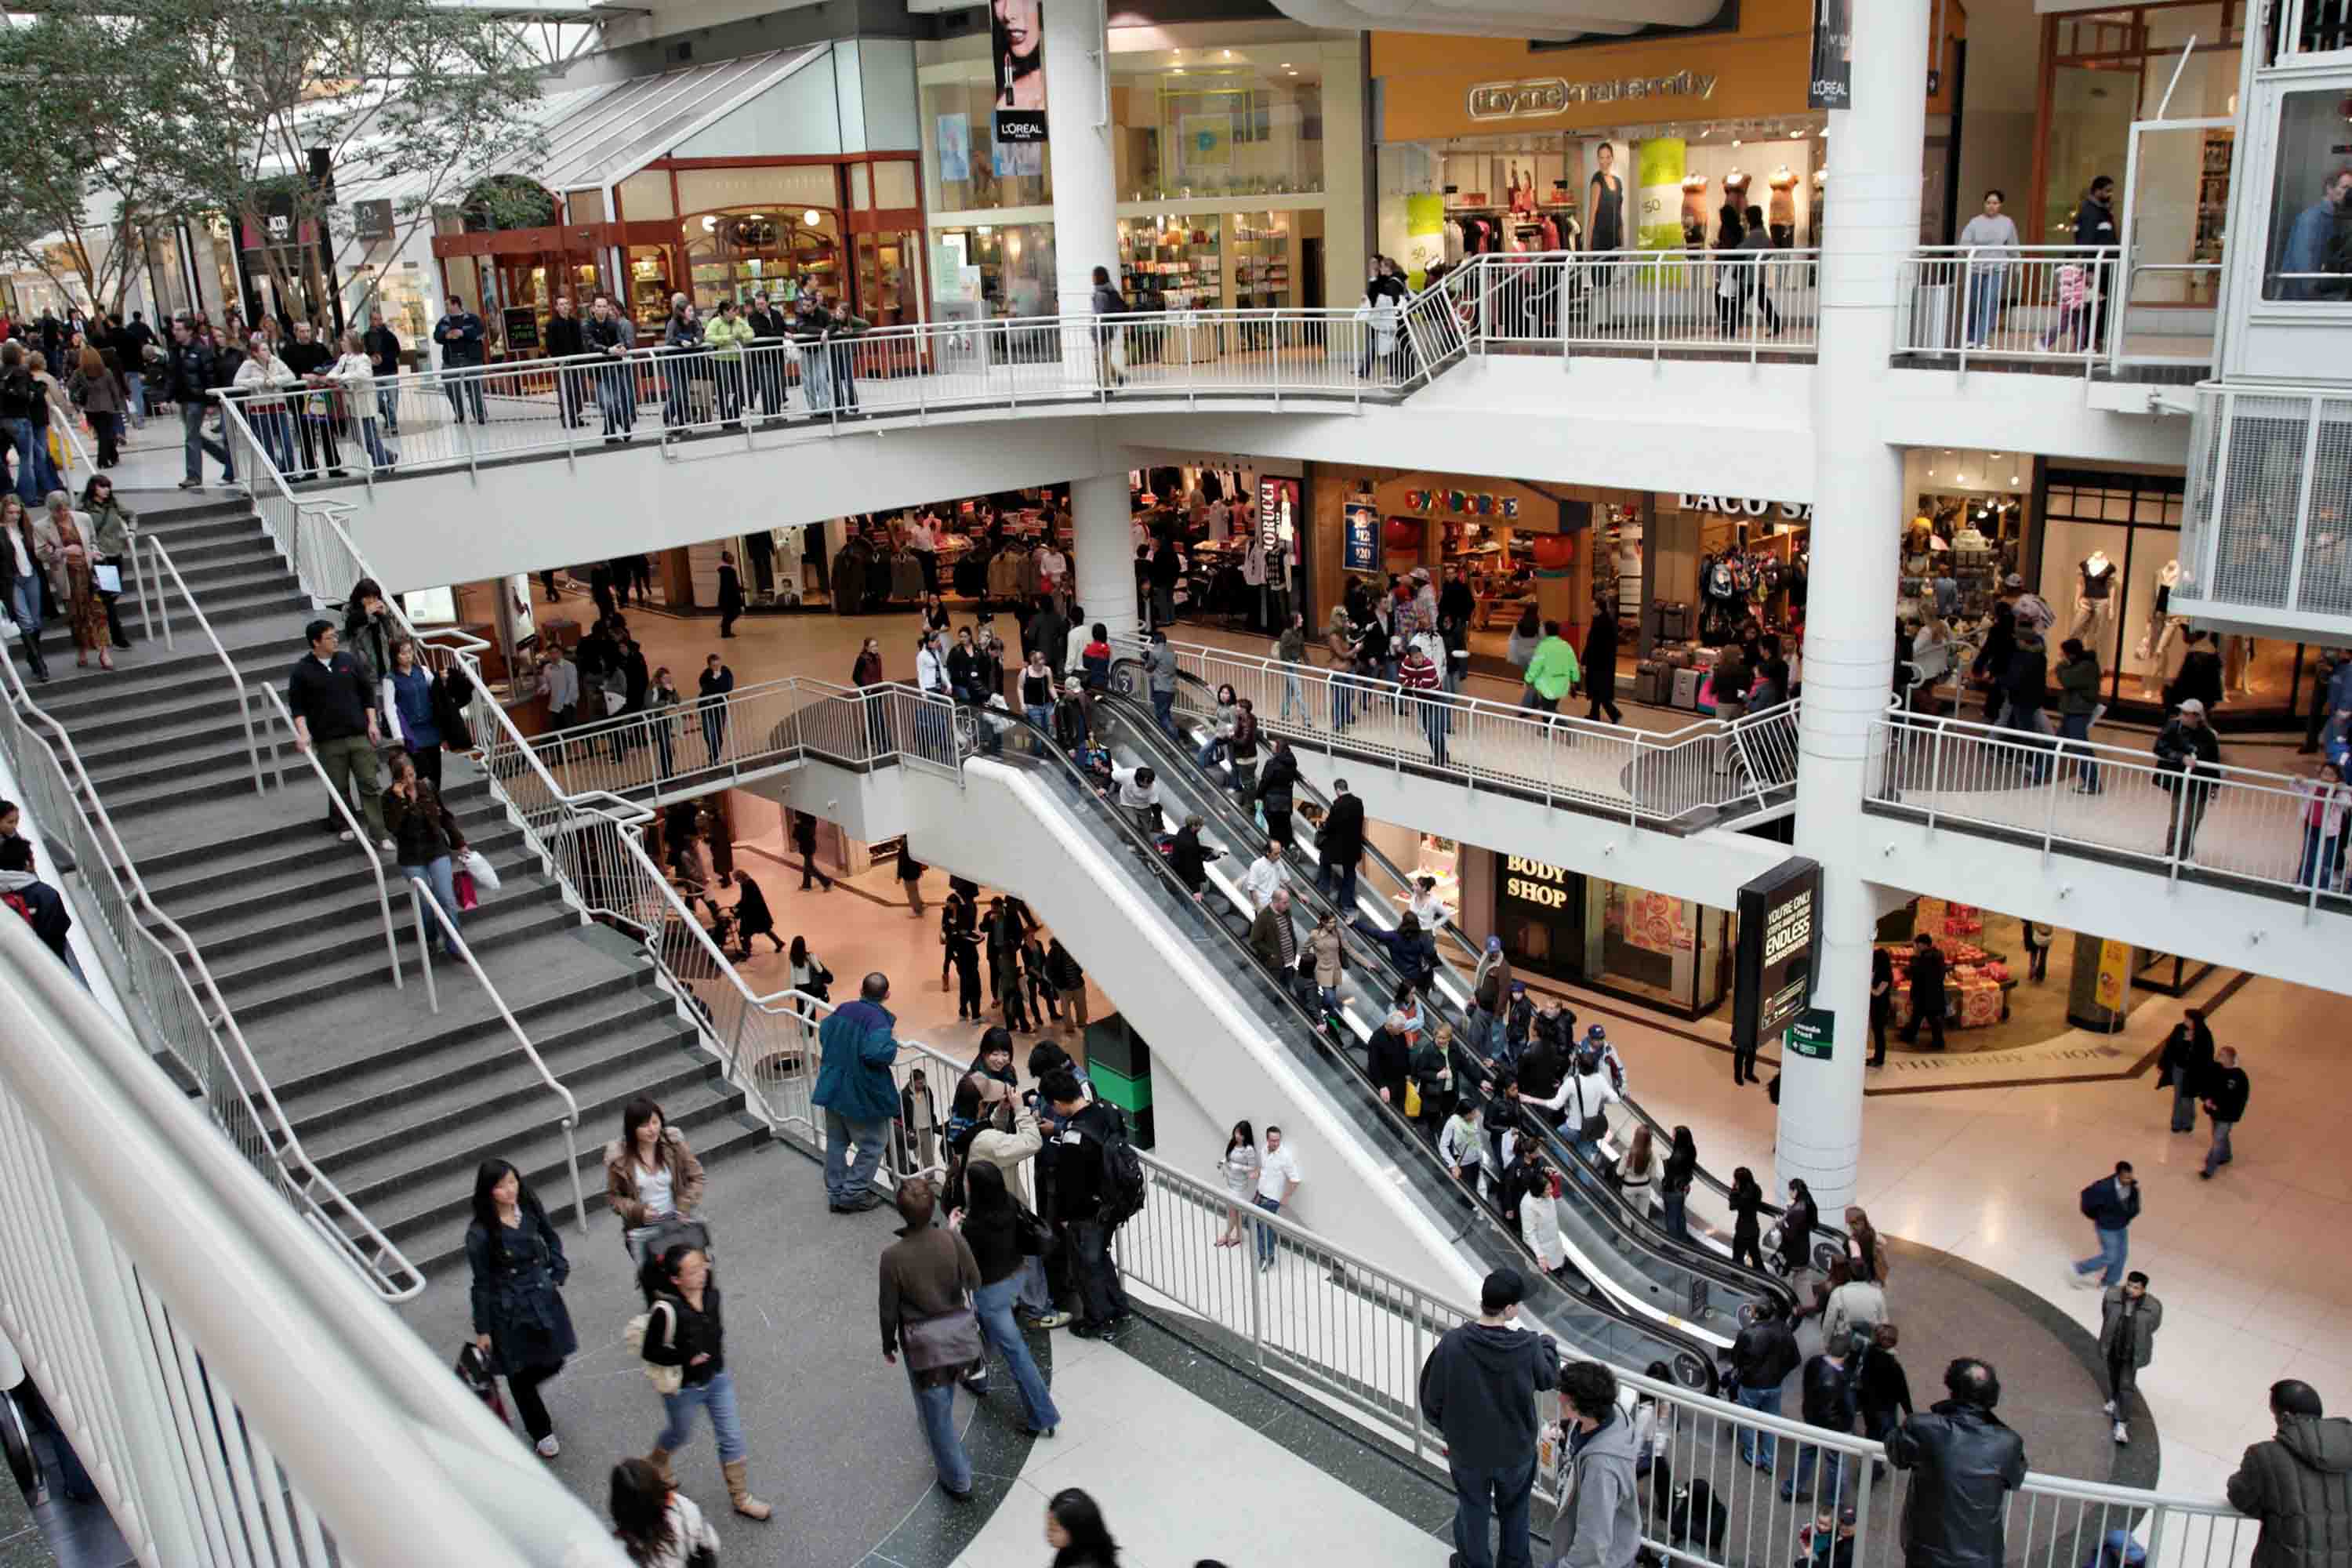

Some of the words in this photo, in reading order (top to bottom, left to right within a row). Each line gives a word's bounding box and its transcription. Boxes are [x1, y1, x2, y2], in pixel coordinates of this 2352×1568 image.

[1567, 69, 1719, 103] maternity
[1261, 482, 1276, 551] IORUCCI
[1404, 488, 1519, 519] GYMBOREE
[1507, 855, 1566, 884] BODY
[1508, 877, 1567, 908] SHOP
[1768, 899, 1793, 925] YOU'RE
[1793, 889, 1812, 910] ONLY
[1766, 915, 1810, 956] ENDLESS
[1686, 1368, 1693, 1385] 1
